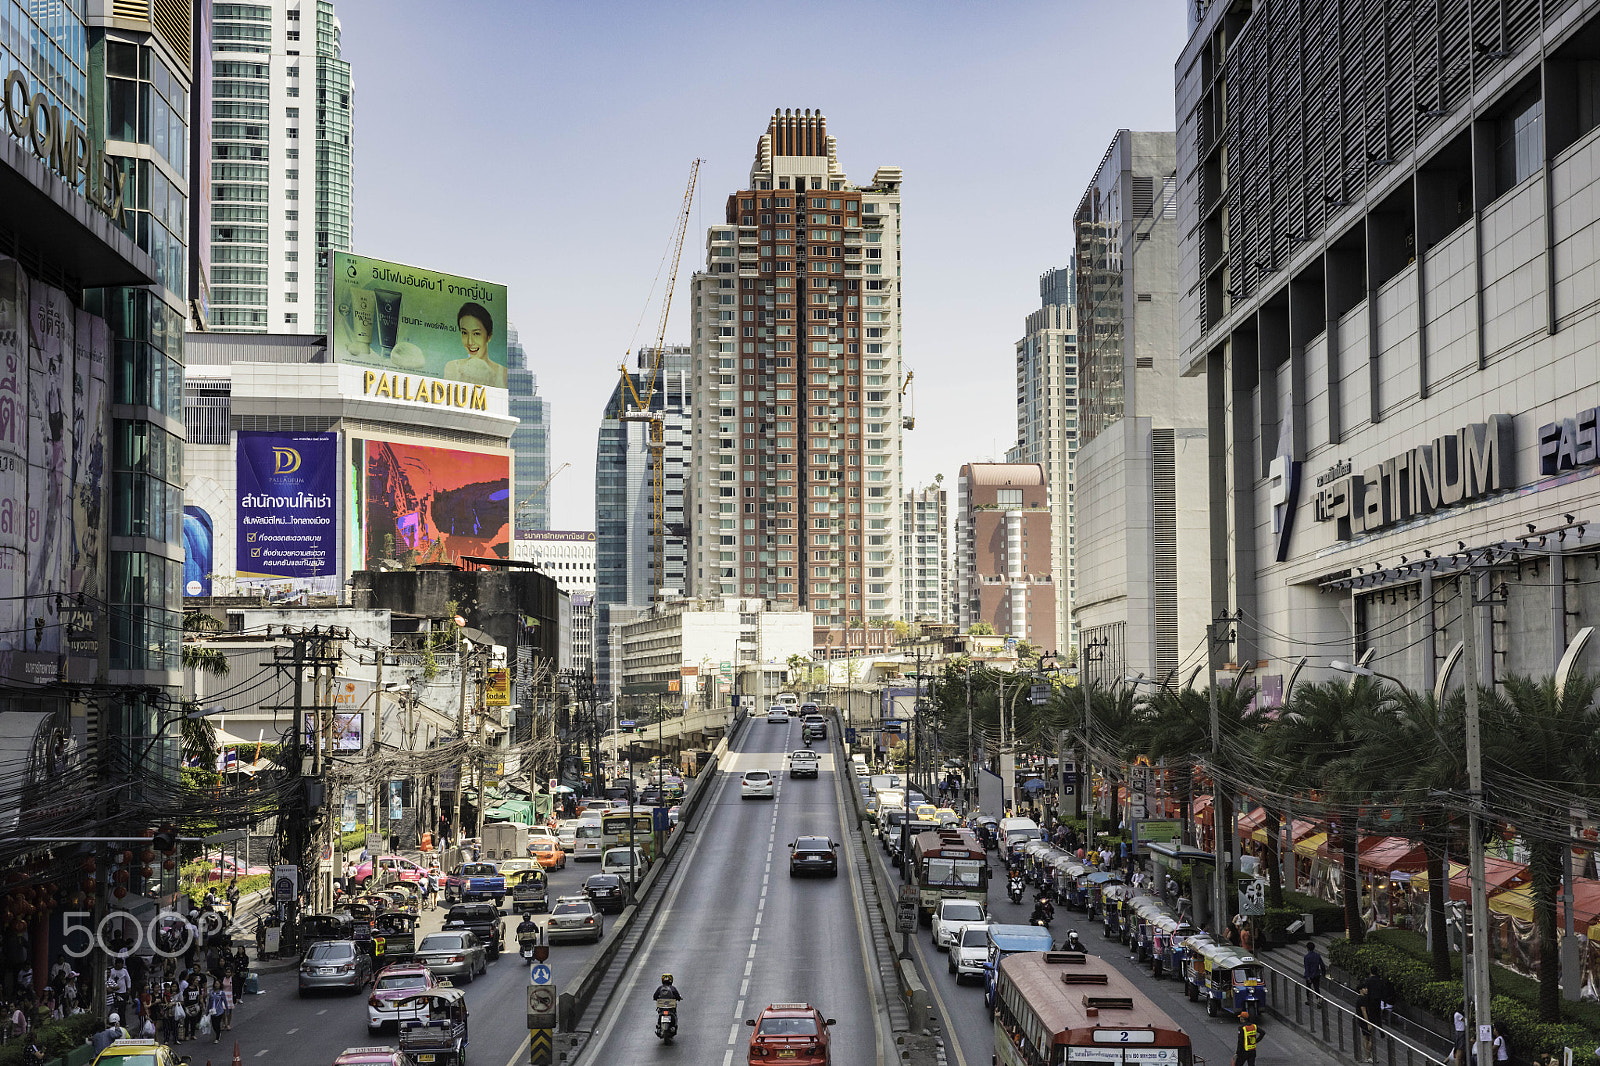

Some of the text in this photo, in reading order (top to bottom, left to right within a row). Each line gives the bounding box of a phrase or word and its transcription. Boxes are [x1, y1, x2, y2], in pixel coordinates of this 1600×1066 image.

[4, 69, 127, 229] COMPLEX
[372, 267, 435, 291] วิปโฟมอันดับ
[448, 284, 493, 304] จากญี่ปุ่น
[364, 370, 488, 411] PALLADIUM
[1538, 405, 1600, 476] FAS
[241, 491, 332, 508] สำนักงานให้เช่า
[1066, 786, 1073, 794] P
[1120, 1031, 1129, 1042] 2
